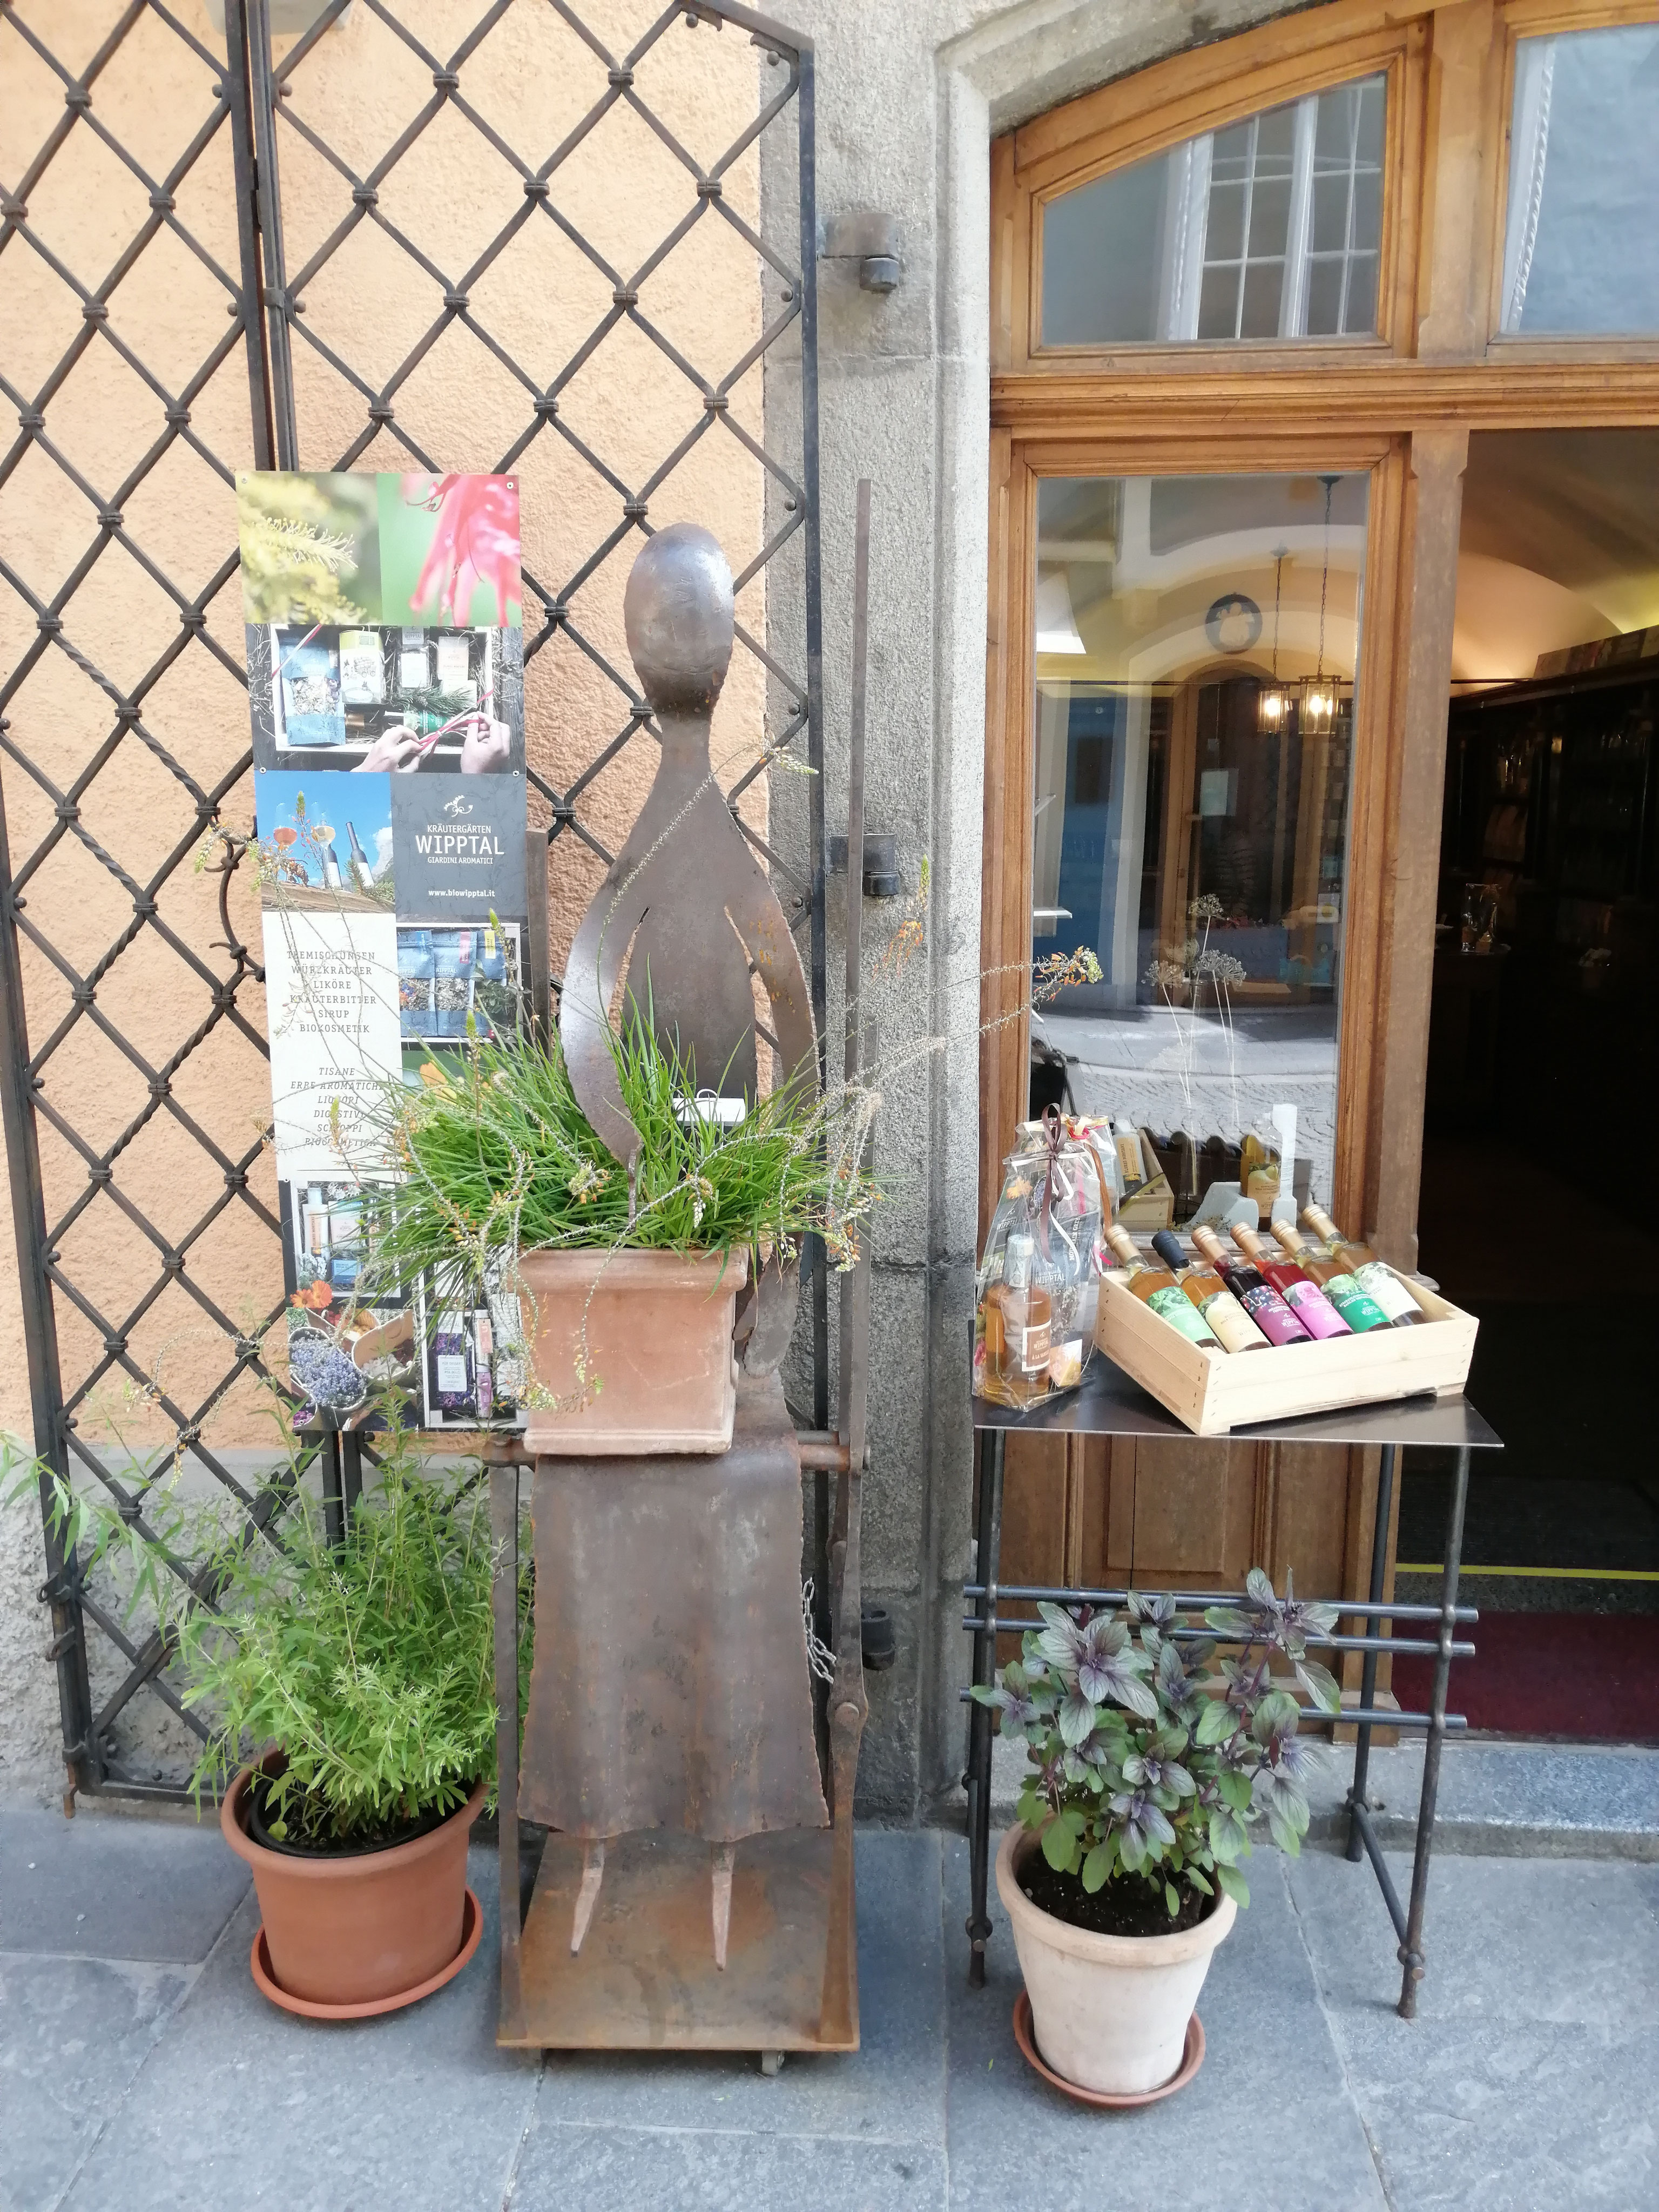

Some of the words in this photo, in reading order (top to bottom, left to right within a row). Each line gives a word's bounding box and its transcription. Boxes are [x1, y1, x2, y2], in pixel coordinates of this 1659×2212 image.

[427, 824, 491, 833] KRÄUTERGÄRTEN
[415, 835, 504, 855] WIPPTAL
[428, 889, 495, 898] www.biowipptal.it
[313, 979, 351, 989] LIKÖRE
[318, 1010, 349, 1018] SIRUP
[300, 1024, 370, 1033] BIOKOSMETIK
[319, 1067, 355, 1076] TISANE
[291, 1081, 316, 1089] ERBE
[318, 1096, 359, 1104] LIQORI
[314, 1110, 365, 1118] DIGSTIVI
[318, 1124, 362, 1132] SCOPPI
[997, 1219, 1017, 1230] WIPPTAL
[1035, 1273, 1065, 1284] WIPPTAL
